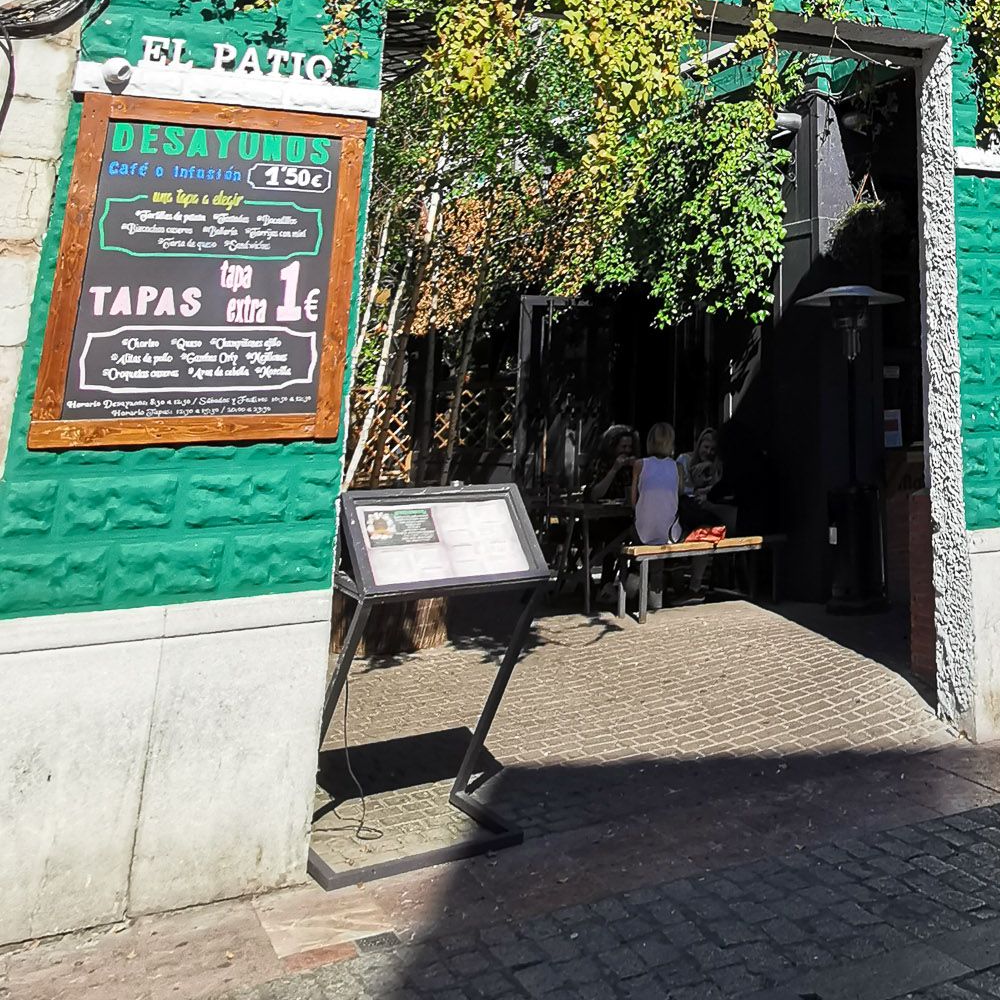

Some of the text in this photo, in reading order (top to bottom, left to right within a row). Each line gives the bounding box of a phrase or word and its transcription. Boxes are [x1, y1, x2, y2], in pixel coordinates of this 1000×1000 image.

[137, 35, 333, 82] EL PATIO
[111, 123, 331, 165] DESAYUNOS
[108, 161, 150, 177] Café
[155, 166, 164, 177] o
[152, 188, 245, 211] una tapa a elegir
[173, 212, 183, 222] de
[279, 231, 292, 239] con
[186, 239, 196, 248] de
[196, 240, 218, 252] queso
[219, 260, 253, 292] tapa
[89, 285, 268, 324] TAPAS extra
[175, 338, 203, 351] Queso
[142, 354, 152, 363] de
[152, 354, 174, 366] pollo
[213, 367, 223, 377] de
[66, 400, 102, 409] Horario
[110, 408, 145, 417] Horario
